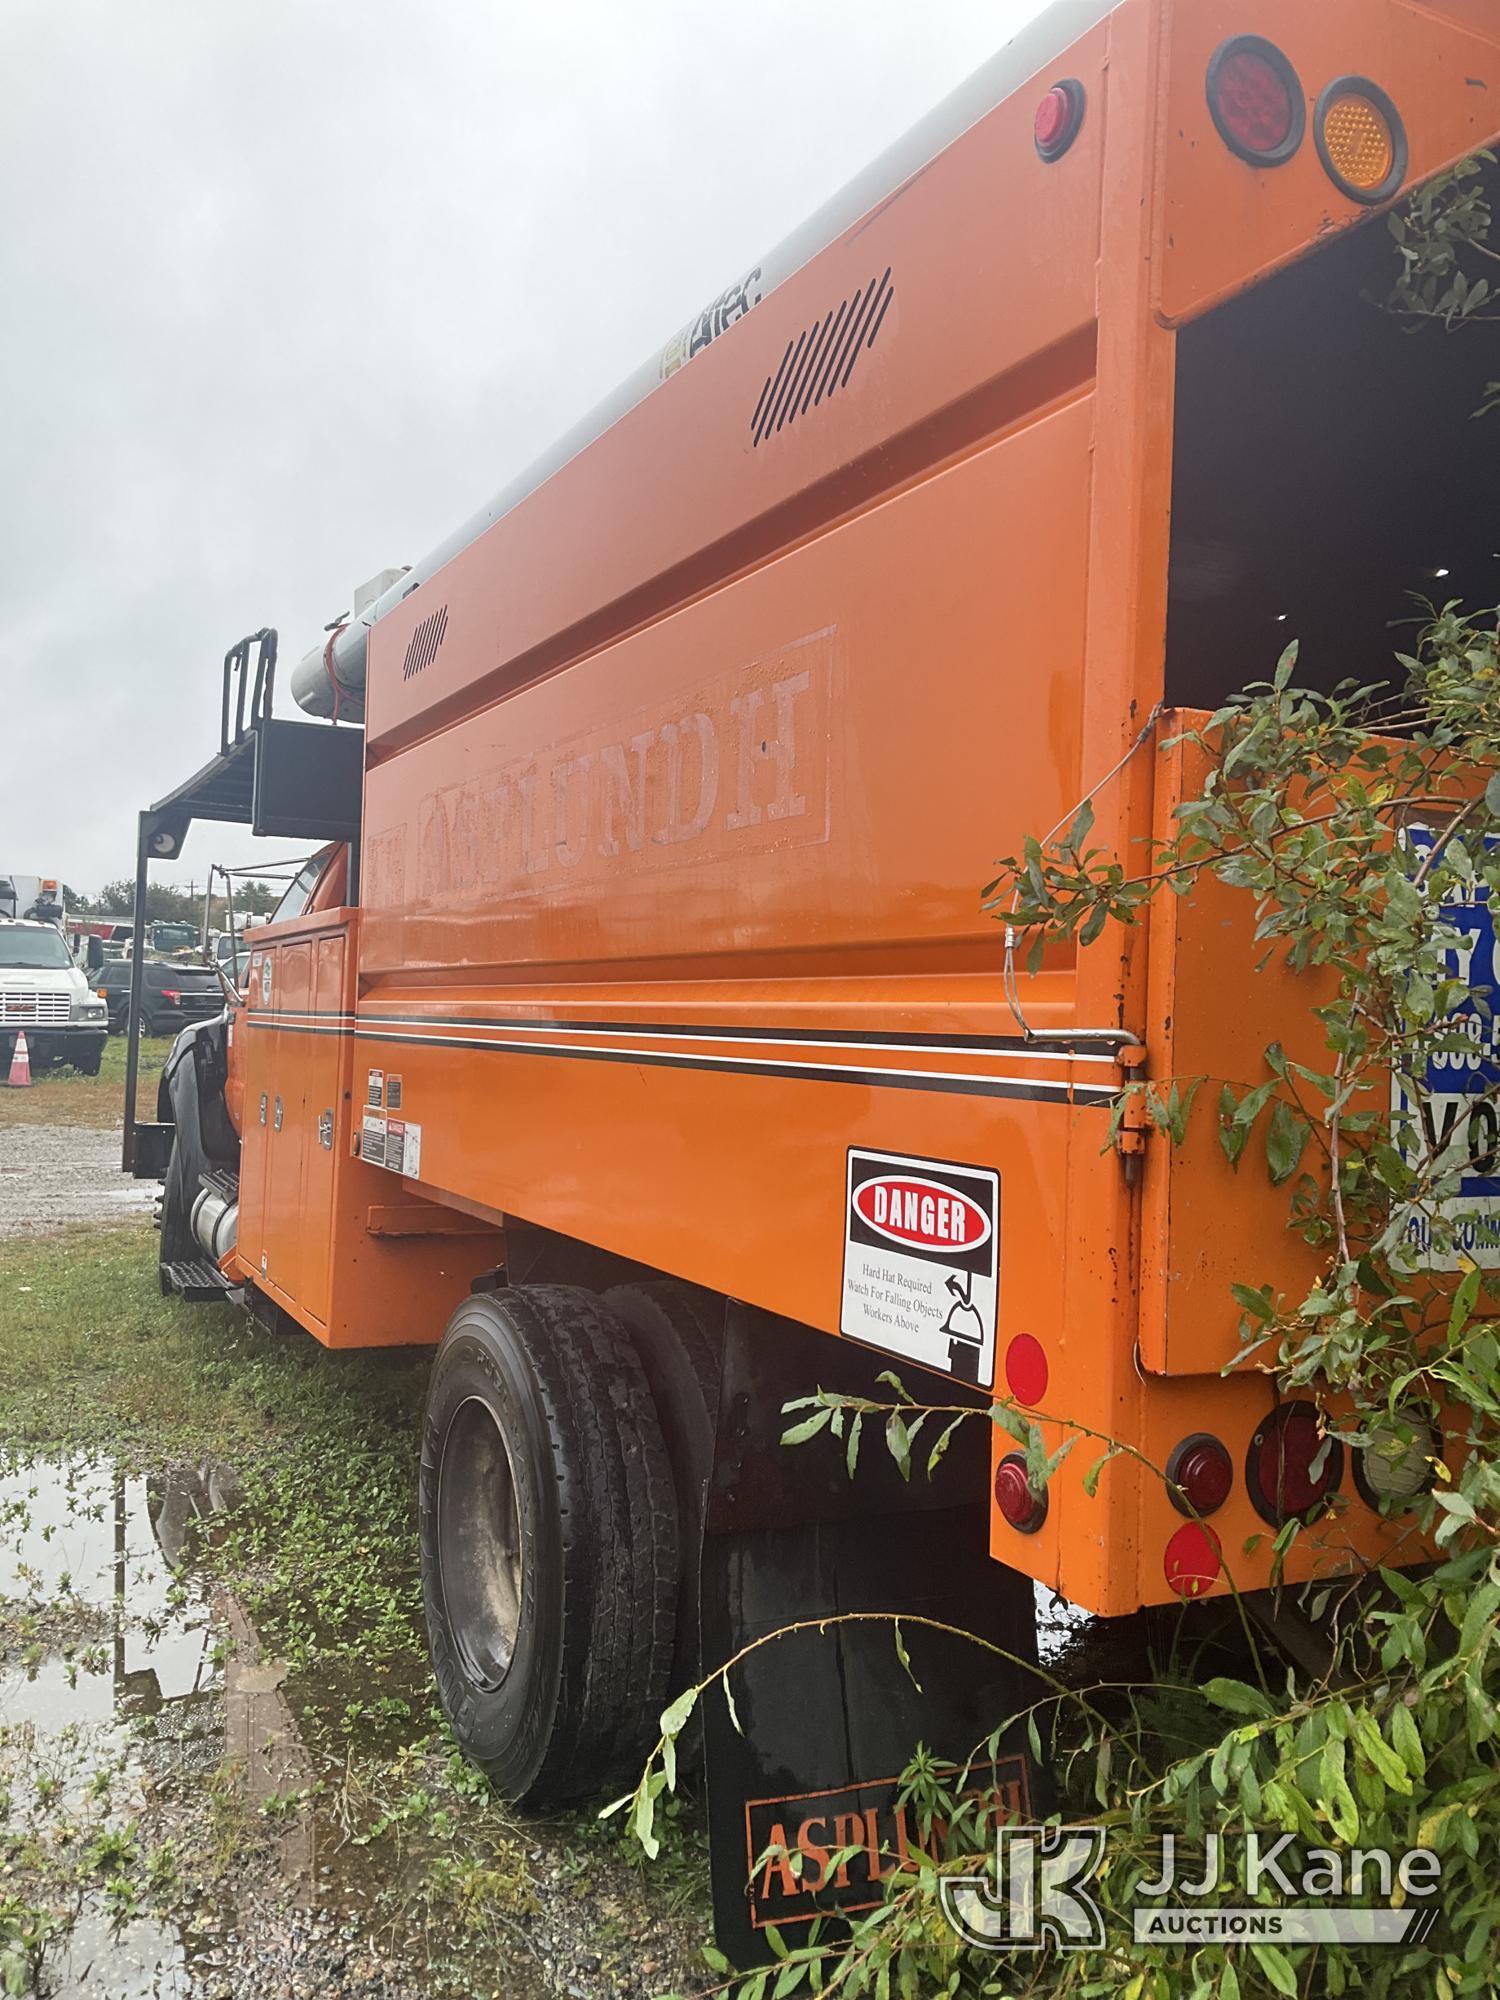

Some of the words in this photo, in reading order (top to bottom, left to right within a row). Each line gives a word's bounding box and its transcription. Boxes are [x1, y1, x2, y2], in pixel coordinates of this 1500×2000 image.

[874, 1184, 967, 1243] DANGER
[848, 1278, 869, 1298] Watch
[870, 1285, 884, 1301] For
[885, 1290, 912, 1313] Falling
[913, 1298, 944, 1320] Objects
[862, 1263, 881, 1281] Hard
[882, 1268, 896, 1285] Hat
[897, 1272, 932, 1295] Required
[863, 1303, 893, 1325] Workers
[894, 1314, 920, 1334] Above
[761, 1780, 1021, 1900] ASPLUH
